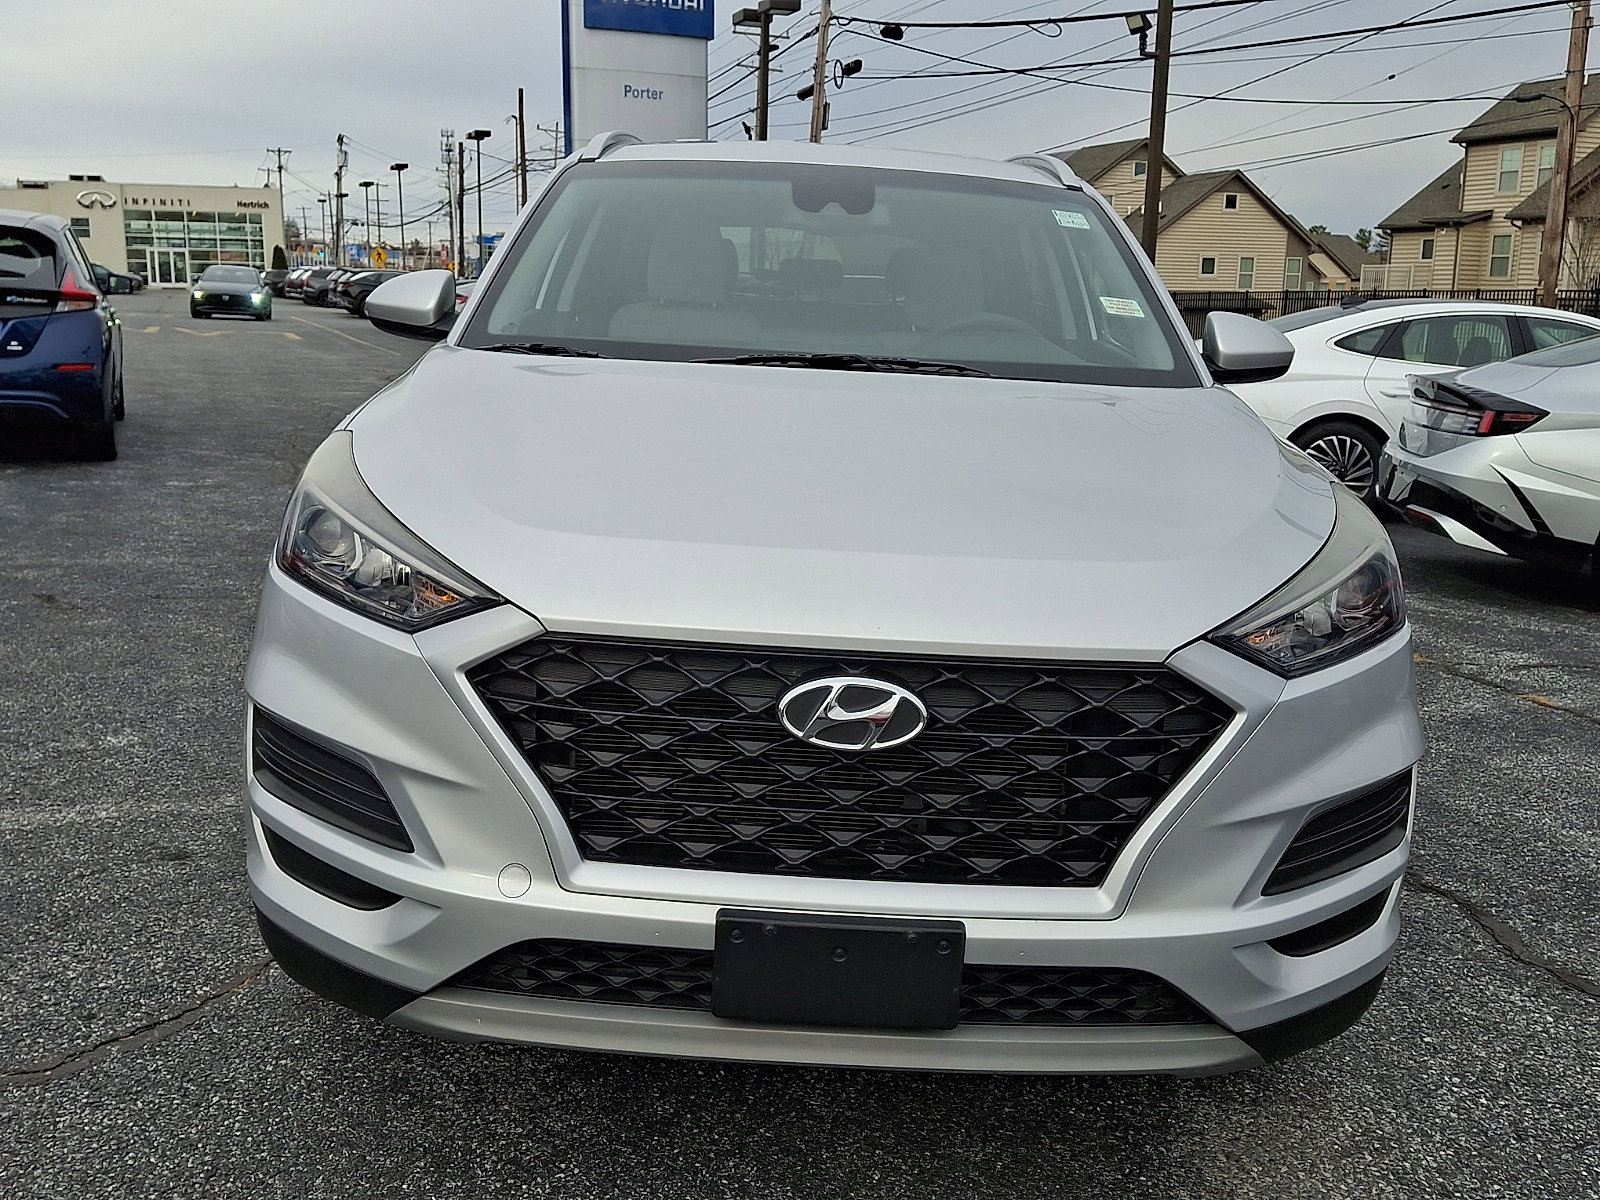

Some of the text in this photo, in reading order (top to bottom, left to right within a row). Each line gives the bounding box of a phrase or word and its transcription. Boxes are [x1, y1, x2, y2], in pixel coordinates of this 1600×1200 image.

[623, 84, 664, 100] Porter
[124, 197, 191, 207] INFINITI
[236, 200, 269, 209] Hertrich
